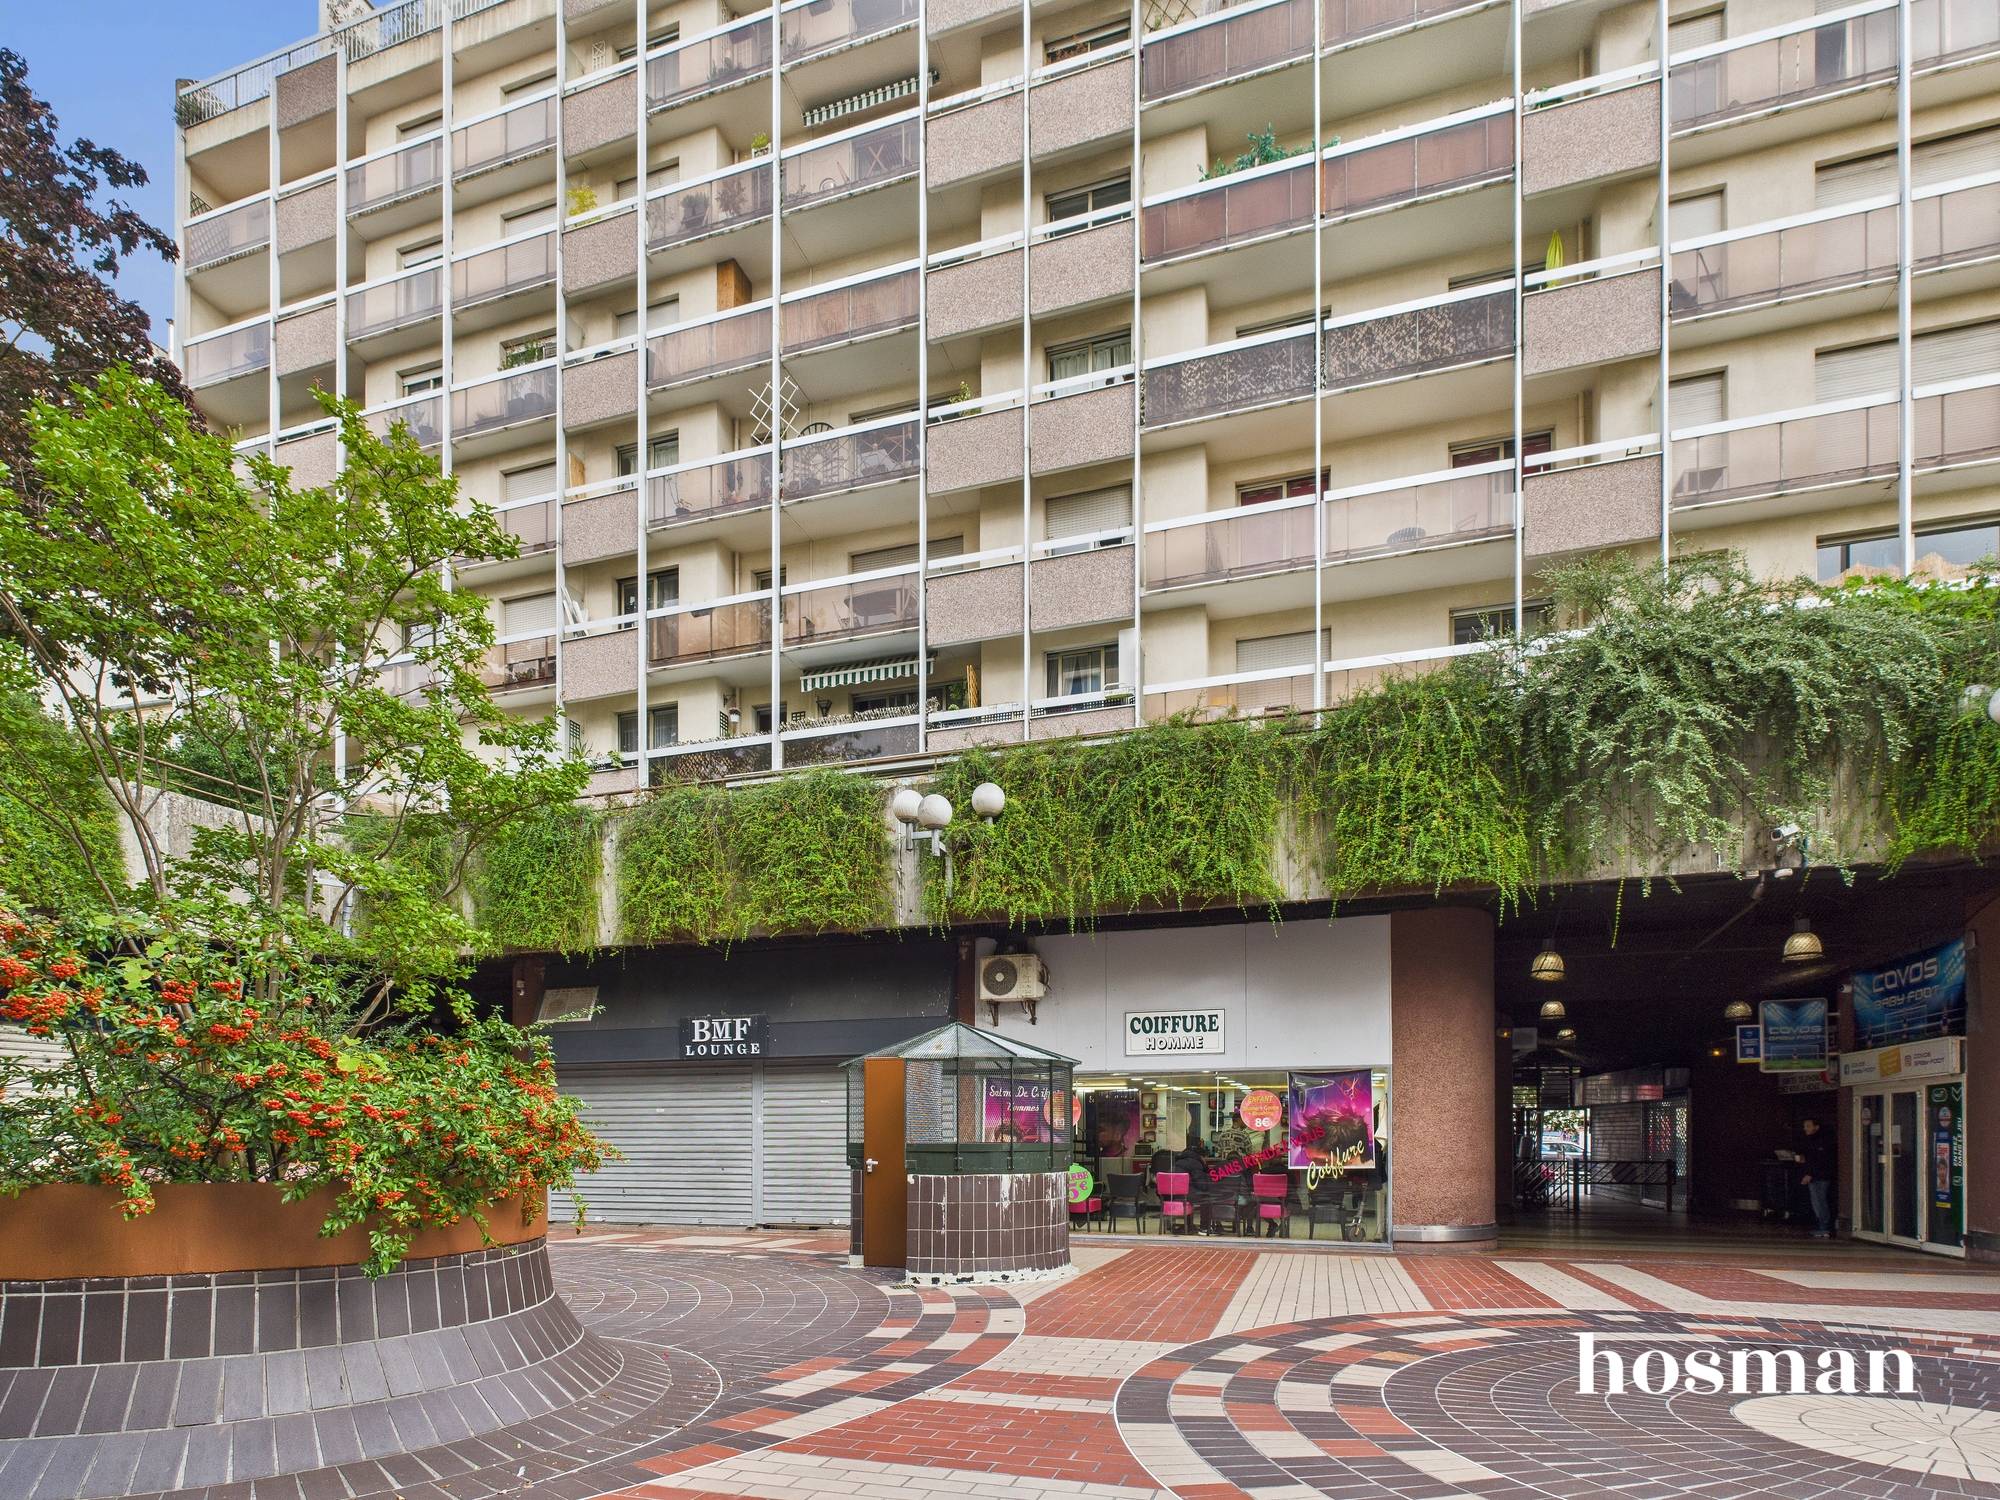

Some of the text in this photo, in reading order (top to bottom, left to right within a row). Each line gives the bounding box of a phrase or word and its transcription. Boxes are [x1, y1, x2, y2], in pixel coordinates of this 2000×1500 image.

[691, 1018, 751, 1042] BMF
[1130, 1014, 1219, 1034] COIFFURE
[685, 1043, 760, 1056] LOUNGE
[1146, 1036, 1204, 1050] HOMME
[1209, 1160, 1242, 1182] SANS
[1307, 1140, 1364, 1190] Coiffure
